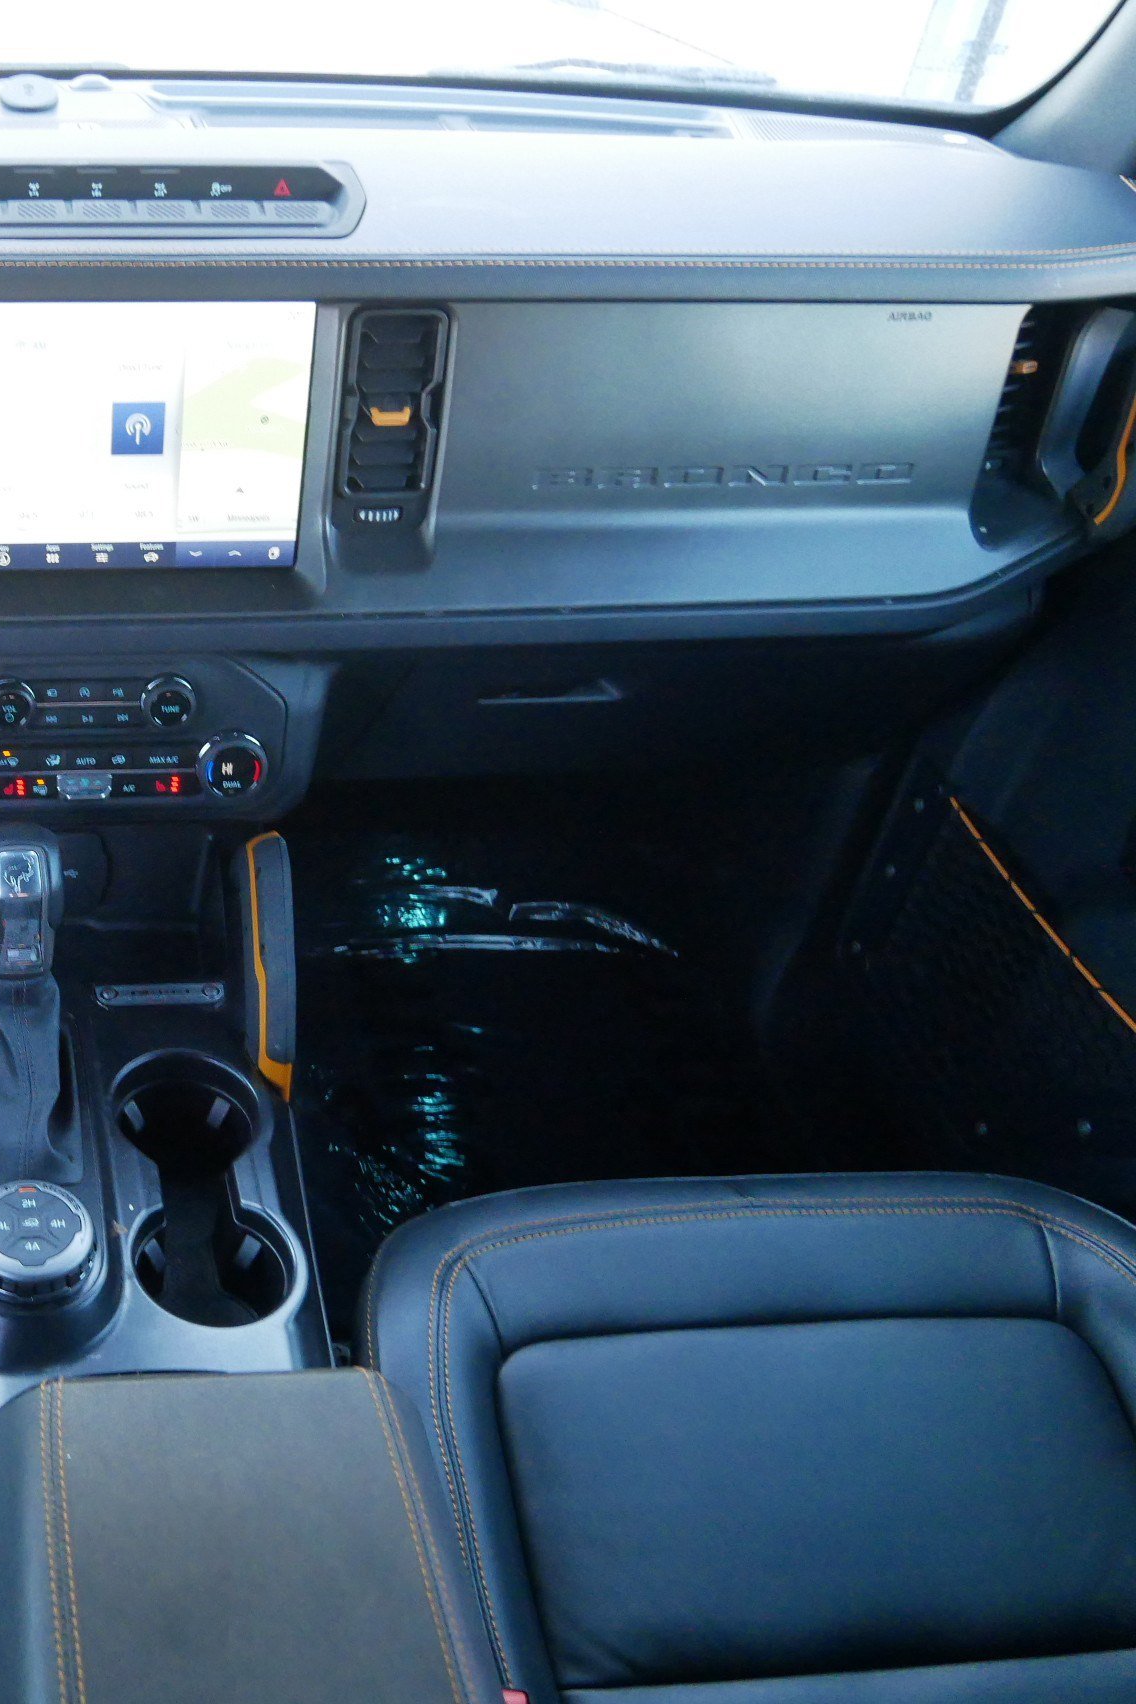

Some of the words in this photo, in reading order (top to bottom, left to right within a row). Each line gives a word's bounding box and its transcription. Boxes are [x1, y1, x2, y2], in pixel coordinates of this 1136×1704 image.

[886, 311, 933, 322] AIRBAG
[531, 462, 915, 490] BRONCO
[45, 544, 60, 553] Apps
[90, 543, 114, 553] Settings
[139, 542, 164, 552] Features
[75, 757, 96, 766] AUTO
[21, 1198, 37, 1209] 2H
[50, 1218, 66, 1229] 4H
[24, 1241, 41, 1252] 4A
